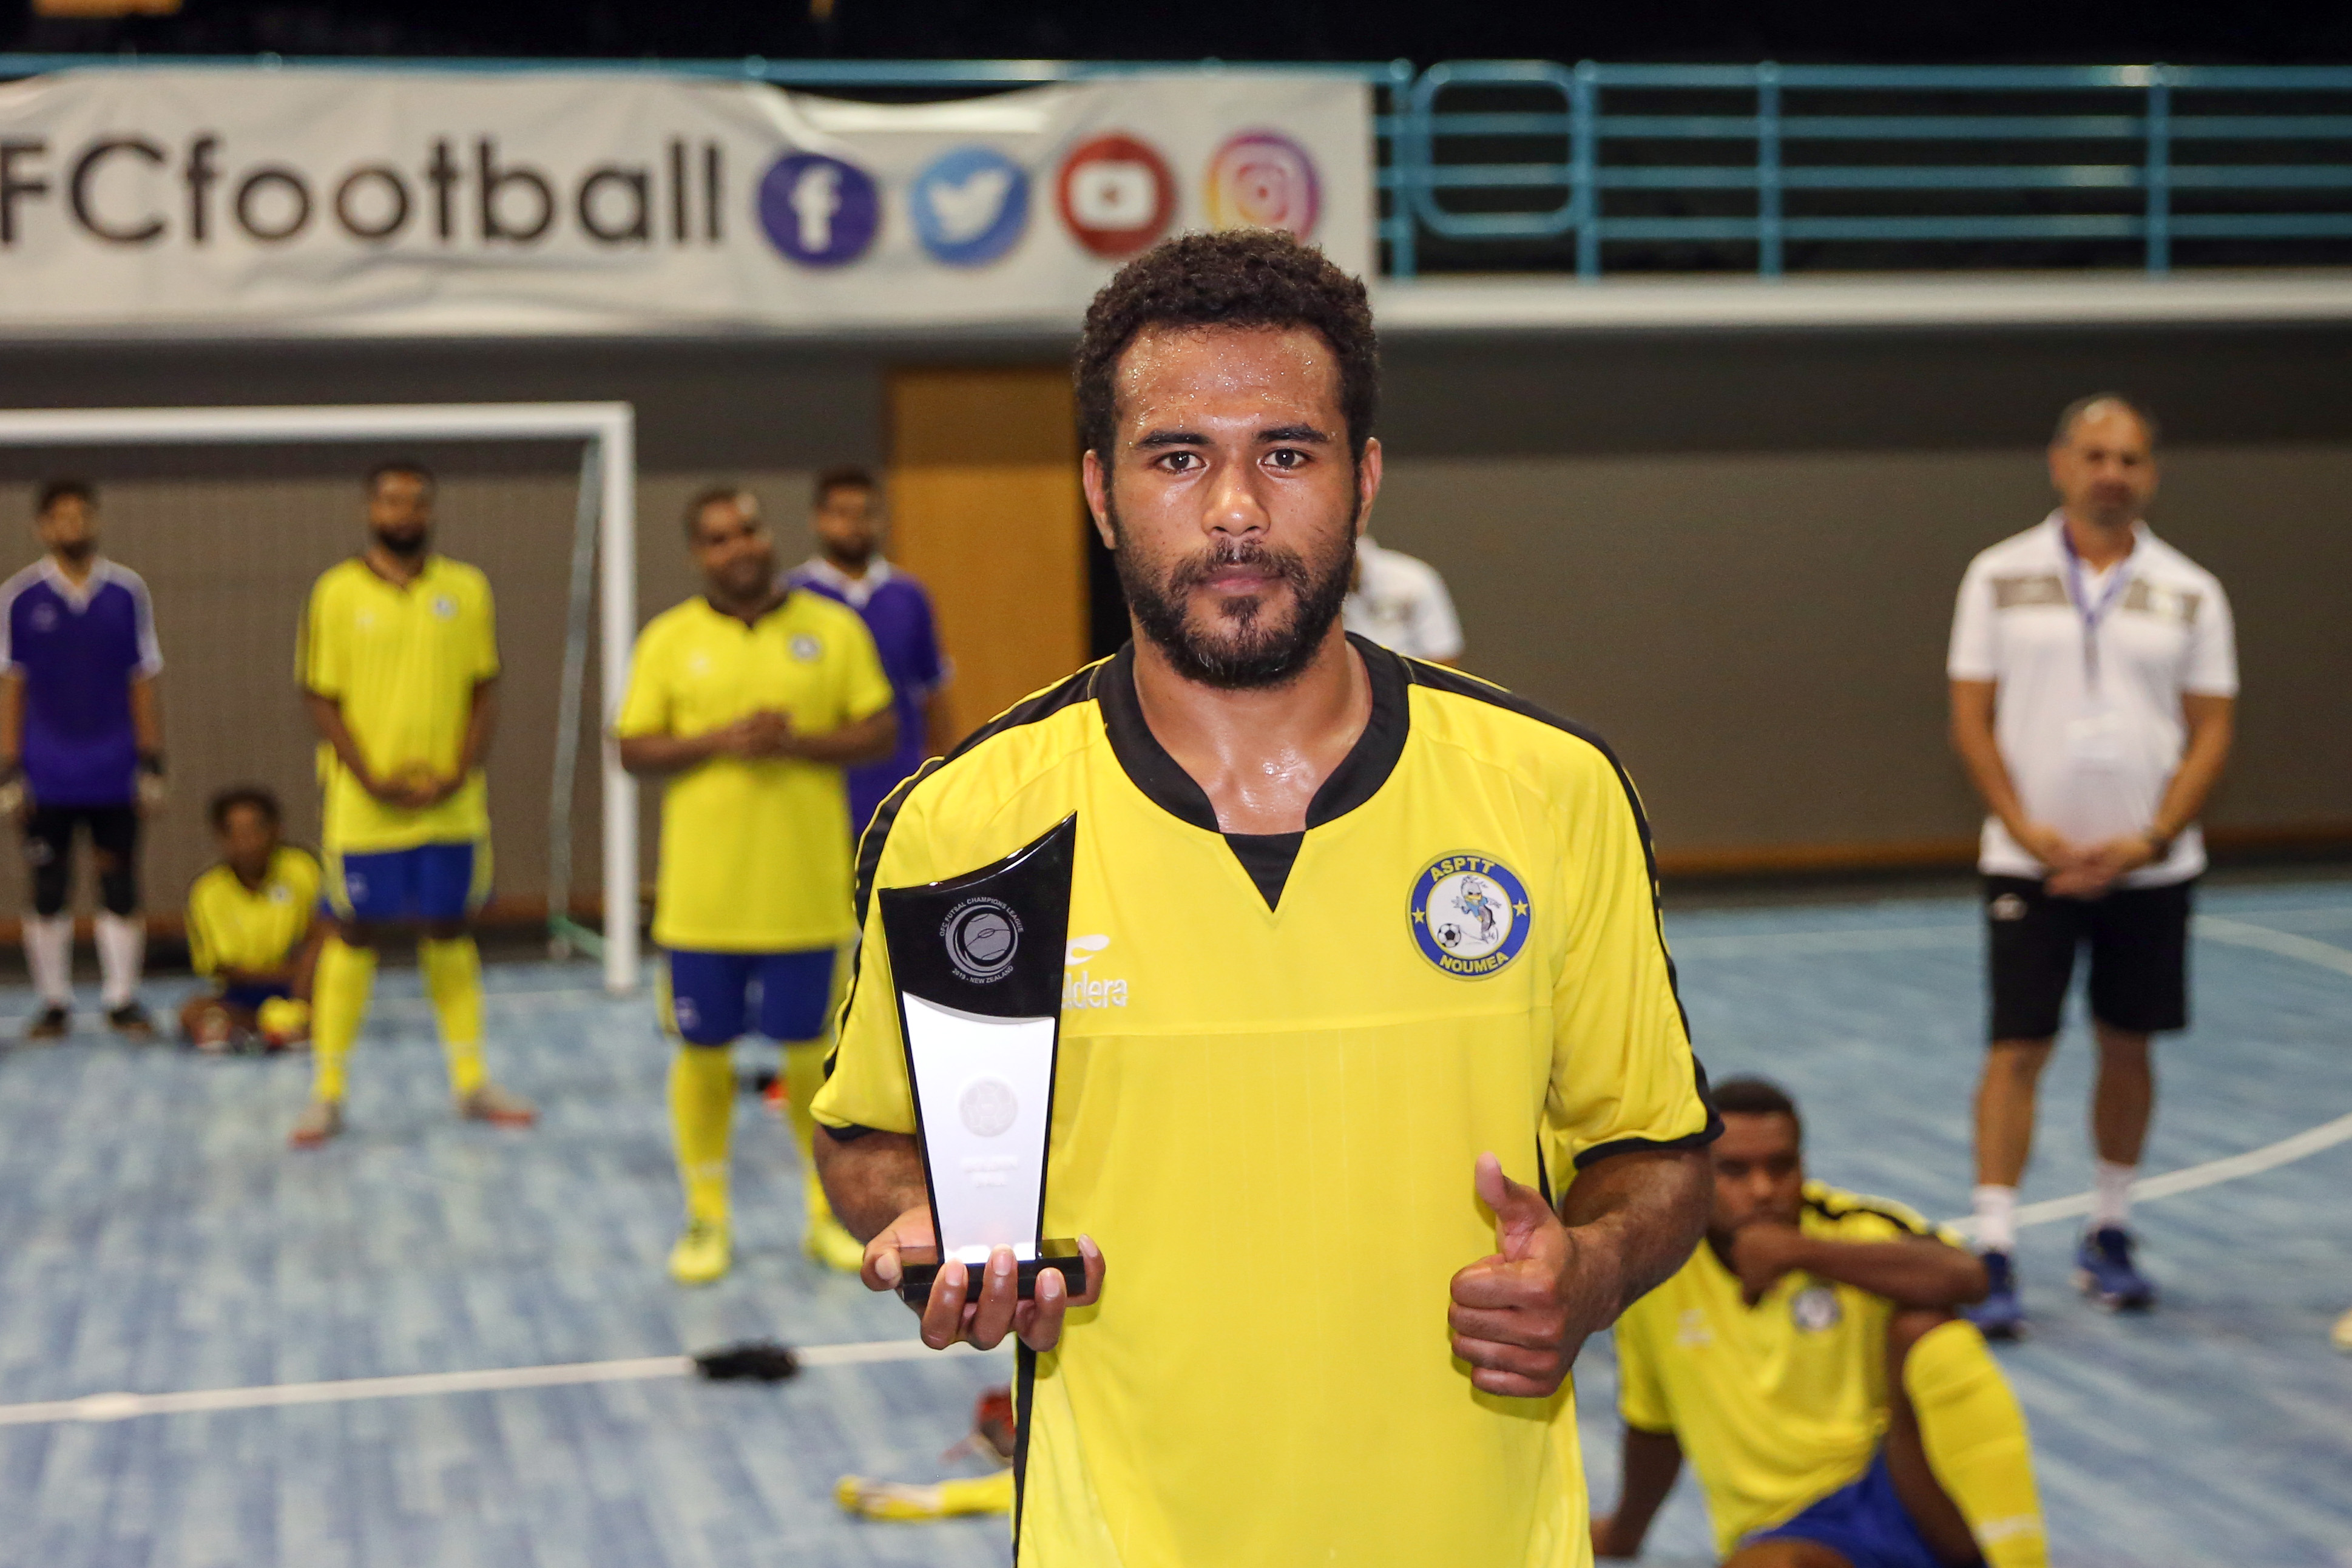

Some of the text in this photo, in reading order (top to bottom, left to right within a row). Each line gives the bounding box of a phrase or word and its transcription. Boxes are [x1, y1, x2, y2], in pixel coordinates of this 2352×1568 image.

[0, 136, 723, 246] FCfootball
[1430, 857, 1495, 882] ASPTT
[945, 902, 966, 922] FUTSAL
[967, 897, 1007, 908] CHAMPIONS
[1006, 907, 1024, 933] LEAGUE
[952, 968, 966, 979] 2019
[985, 965, 1014, 983] ZEALAND
[1440, 951, 1509, 973] NOUMEA
[1061, 970, 1127, 1009] ldera
